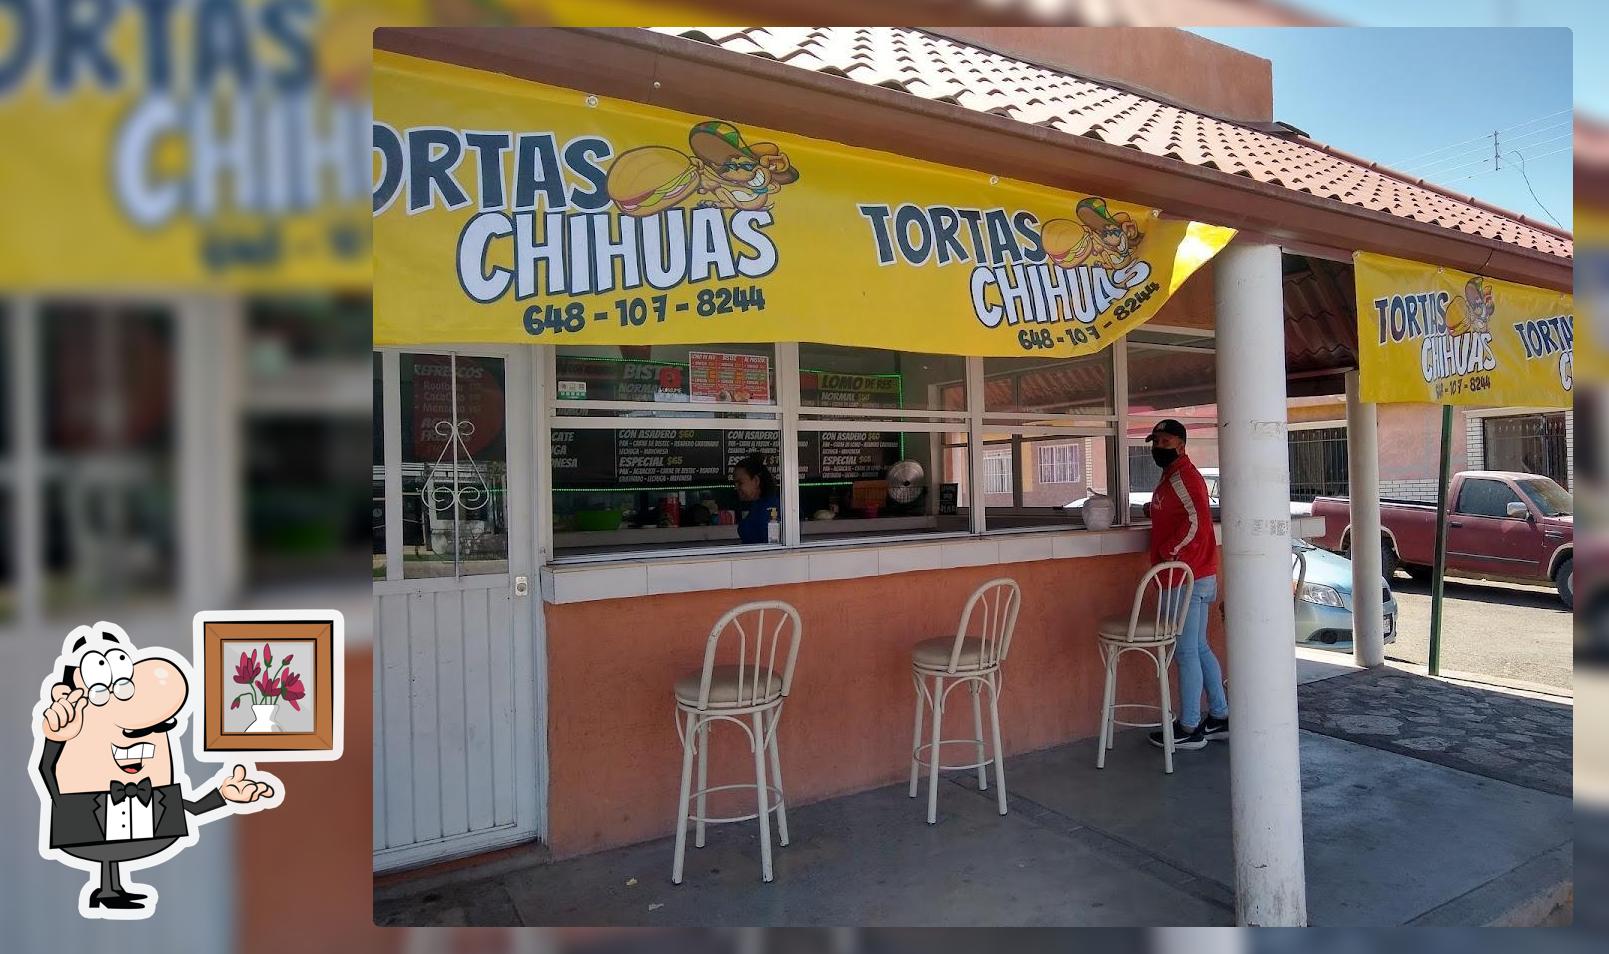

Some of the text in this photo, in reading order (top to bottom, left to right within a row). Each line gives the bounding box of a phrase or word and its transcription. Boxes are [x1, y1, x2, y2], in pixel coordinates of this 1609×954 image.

[856, 203, 1049, 267] TORTAS
[456, 207, 778, 303] CHIHUAS
[970, 260, 1151, 328] CHIHUAS
[1374, 290, 1449, 346] TORTAS
[1421, 332, 1496, 383] CHIHUAS
[822, 375, 863, 389] LOMO
[619, 431, 637, 439] CON
[638, 431, 676, 439] ASADERO
[728, 431, 778, 440] CON ASADERO
[823, 432, 836, 440] CON
[837, 432, 867, 440] ASADERO
[620, 457, 664, 466] ESPECIAL
[823, 456, 857, 465] ESPECIAL
